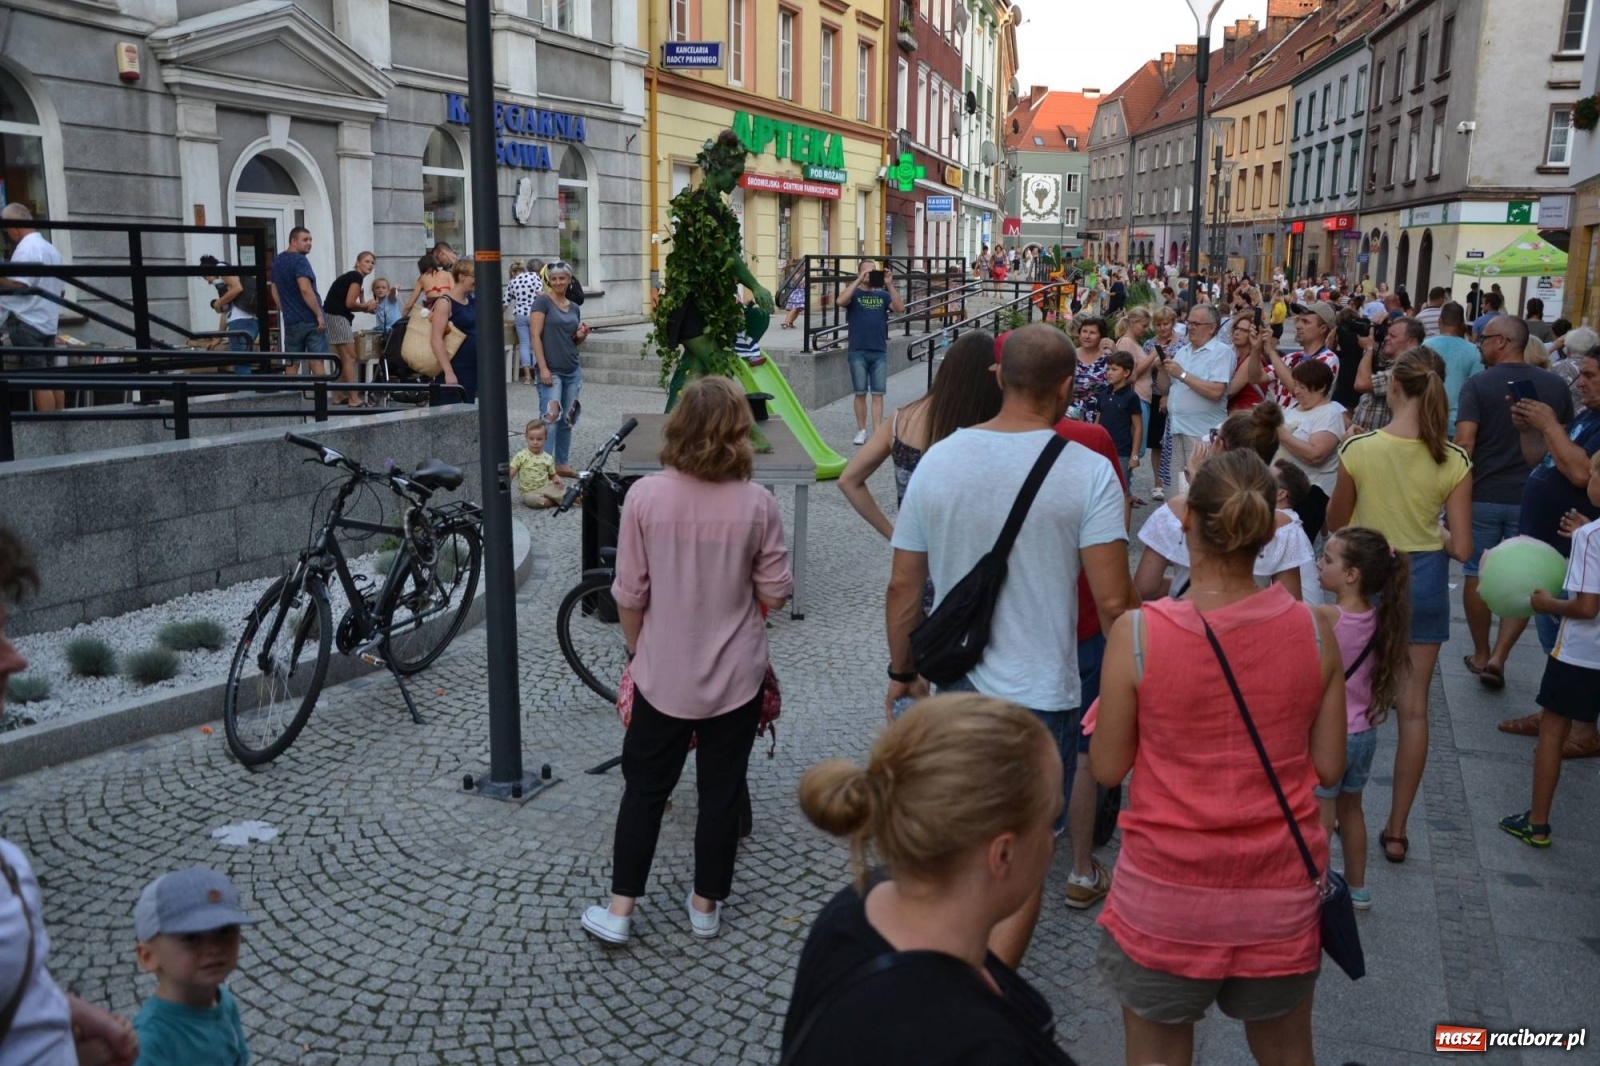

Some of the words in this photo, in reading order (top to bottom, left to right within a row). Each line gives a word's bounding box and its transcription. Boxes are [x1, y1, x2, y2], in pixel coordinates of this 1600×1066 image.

[675, 46, 708, 54] KANCELARIA
[666, 56, 685, 64] RADCY
[685, 56, 717, 64] PRAWNEGO
[447, 93, 586, 142] KĘGARNIA
[732, 110, 845, 169] APTEKA
[810, 168, 823, 178] POD
[783, 181, 804, 191] CENTRUM
